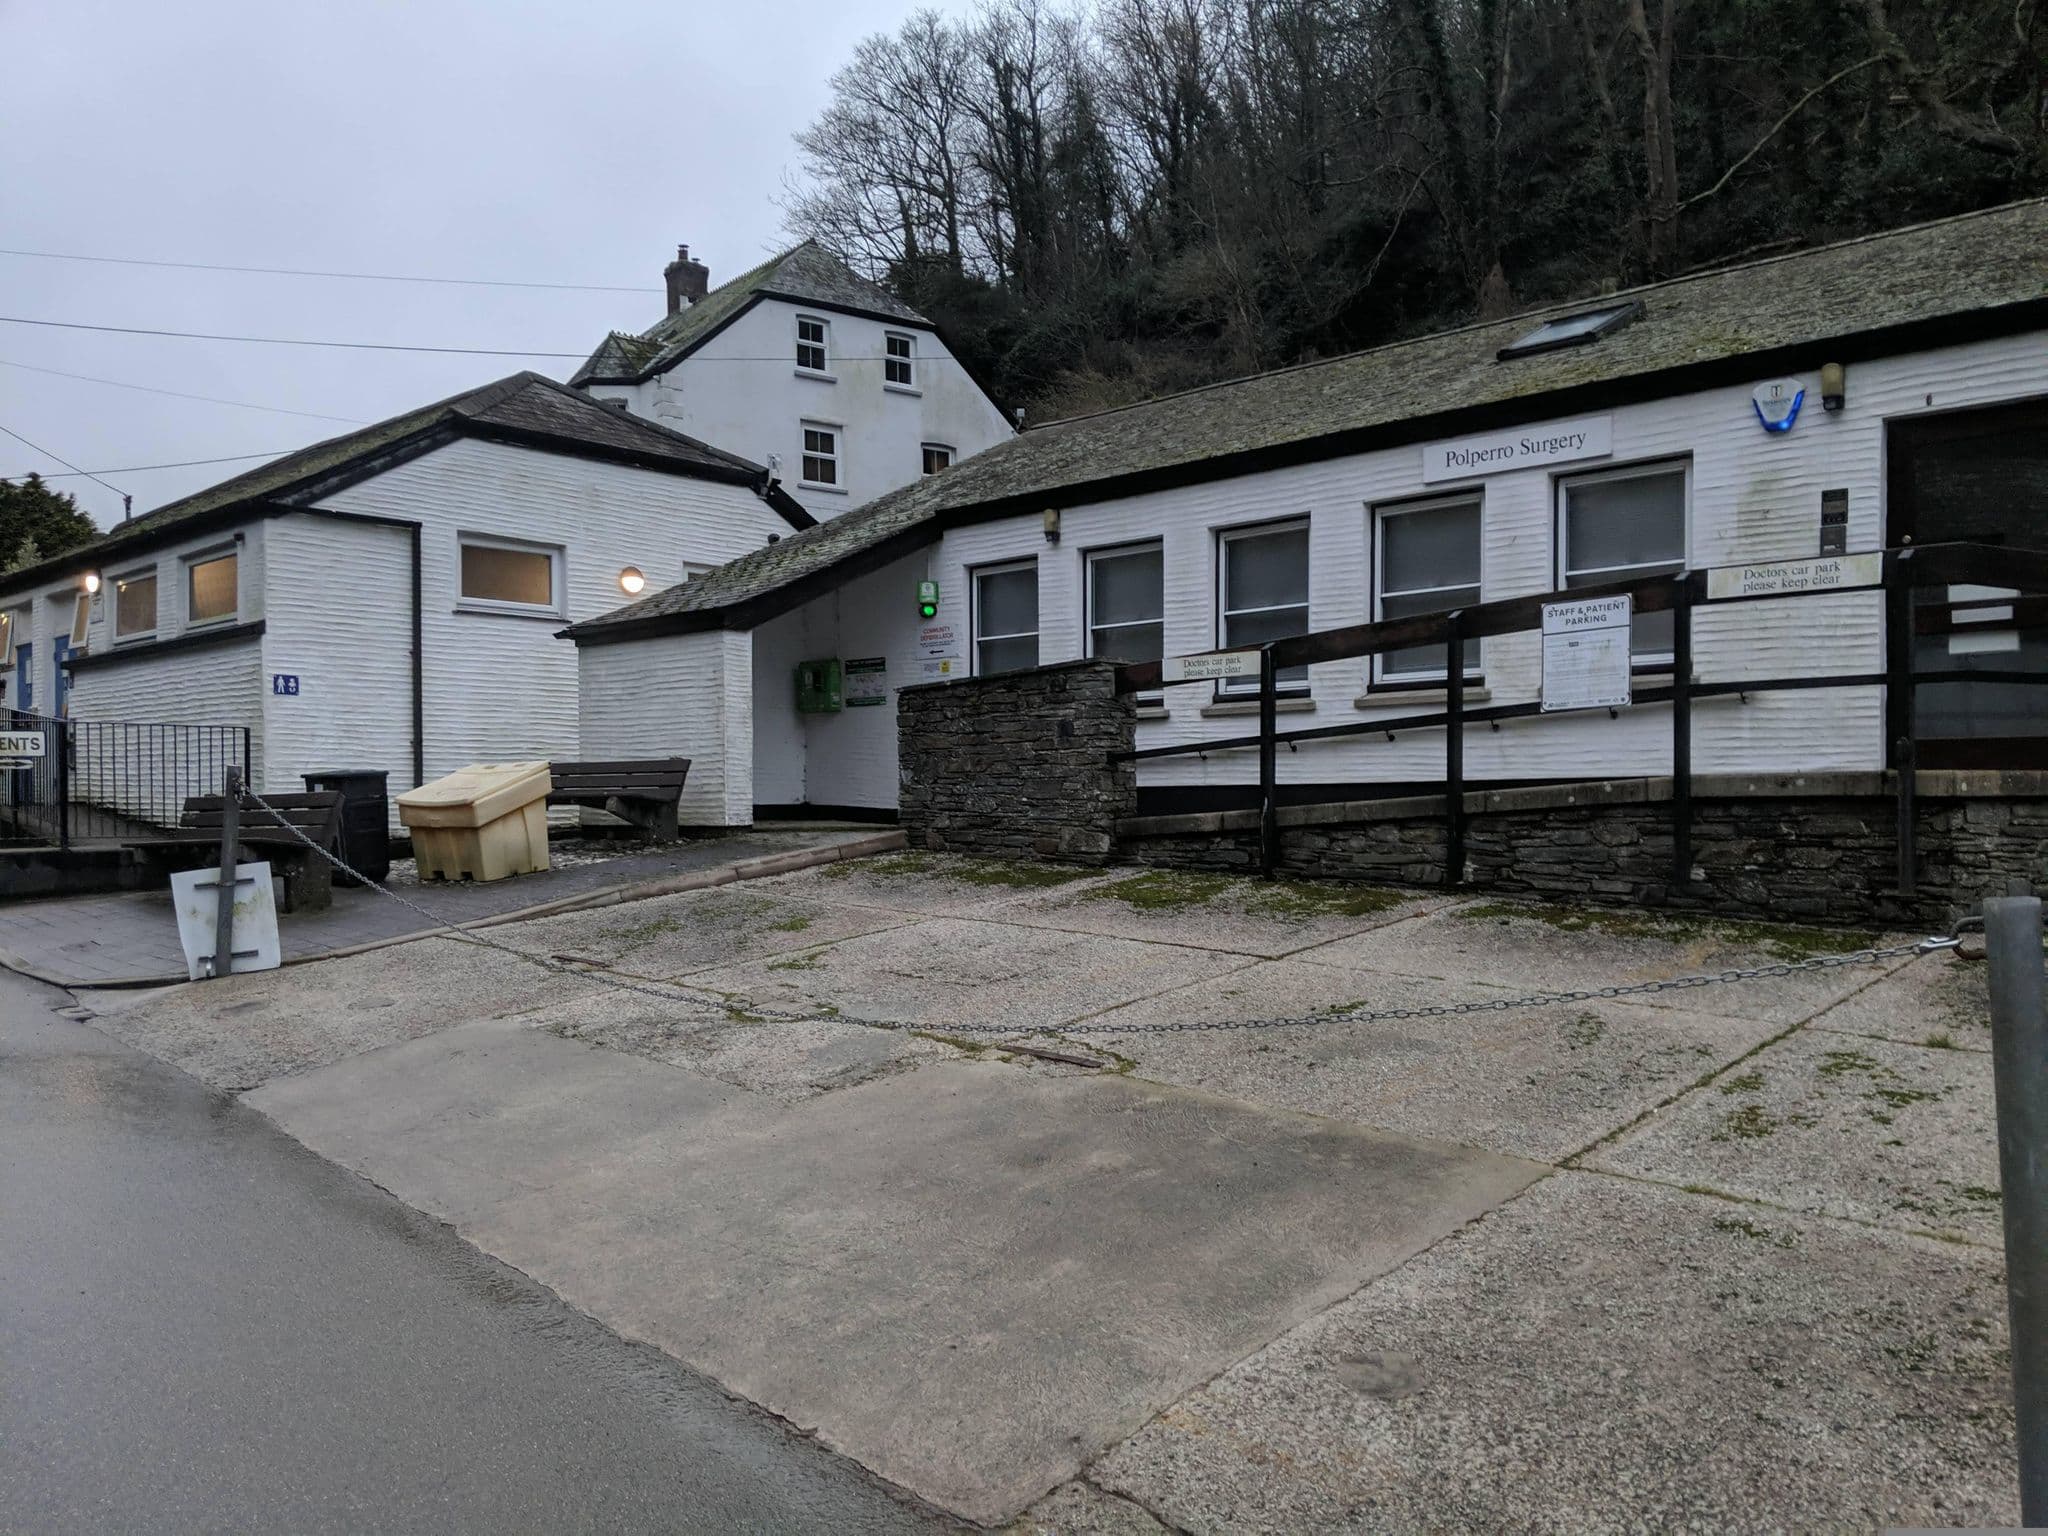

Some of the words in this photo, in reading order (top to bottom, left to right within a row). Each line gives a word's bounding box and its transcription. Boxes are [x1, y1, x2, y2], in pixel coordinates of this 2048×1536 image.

[1445, 445, 1514, 467] Polperro
[1520, 432, 1586, 455] Surgery
[1744, 567, 1788, 581] Doctors
[1791, 565, 1811, 576] car
[1815, 561, 1841, 577] park
[1743, 580, 1777, 593] please
[1781, 577, 1808, 590] keep
[1812, 575, 1841, 585] clear
[1547, 607, 1576, 618] STAFF
[1586, 601, 1625, 614] PATIENT
[1565, 614, 1608, 625] PARKING
[1212, 658, 1223, 666] car
[1225, 656, 1241, 666] park
[1184, 668, 1204, 678] please
[1207, 666, 1222, 675] keep
[1224, 665, 1241, 674] clear
